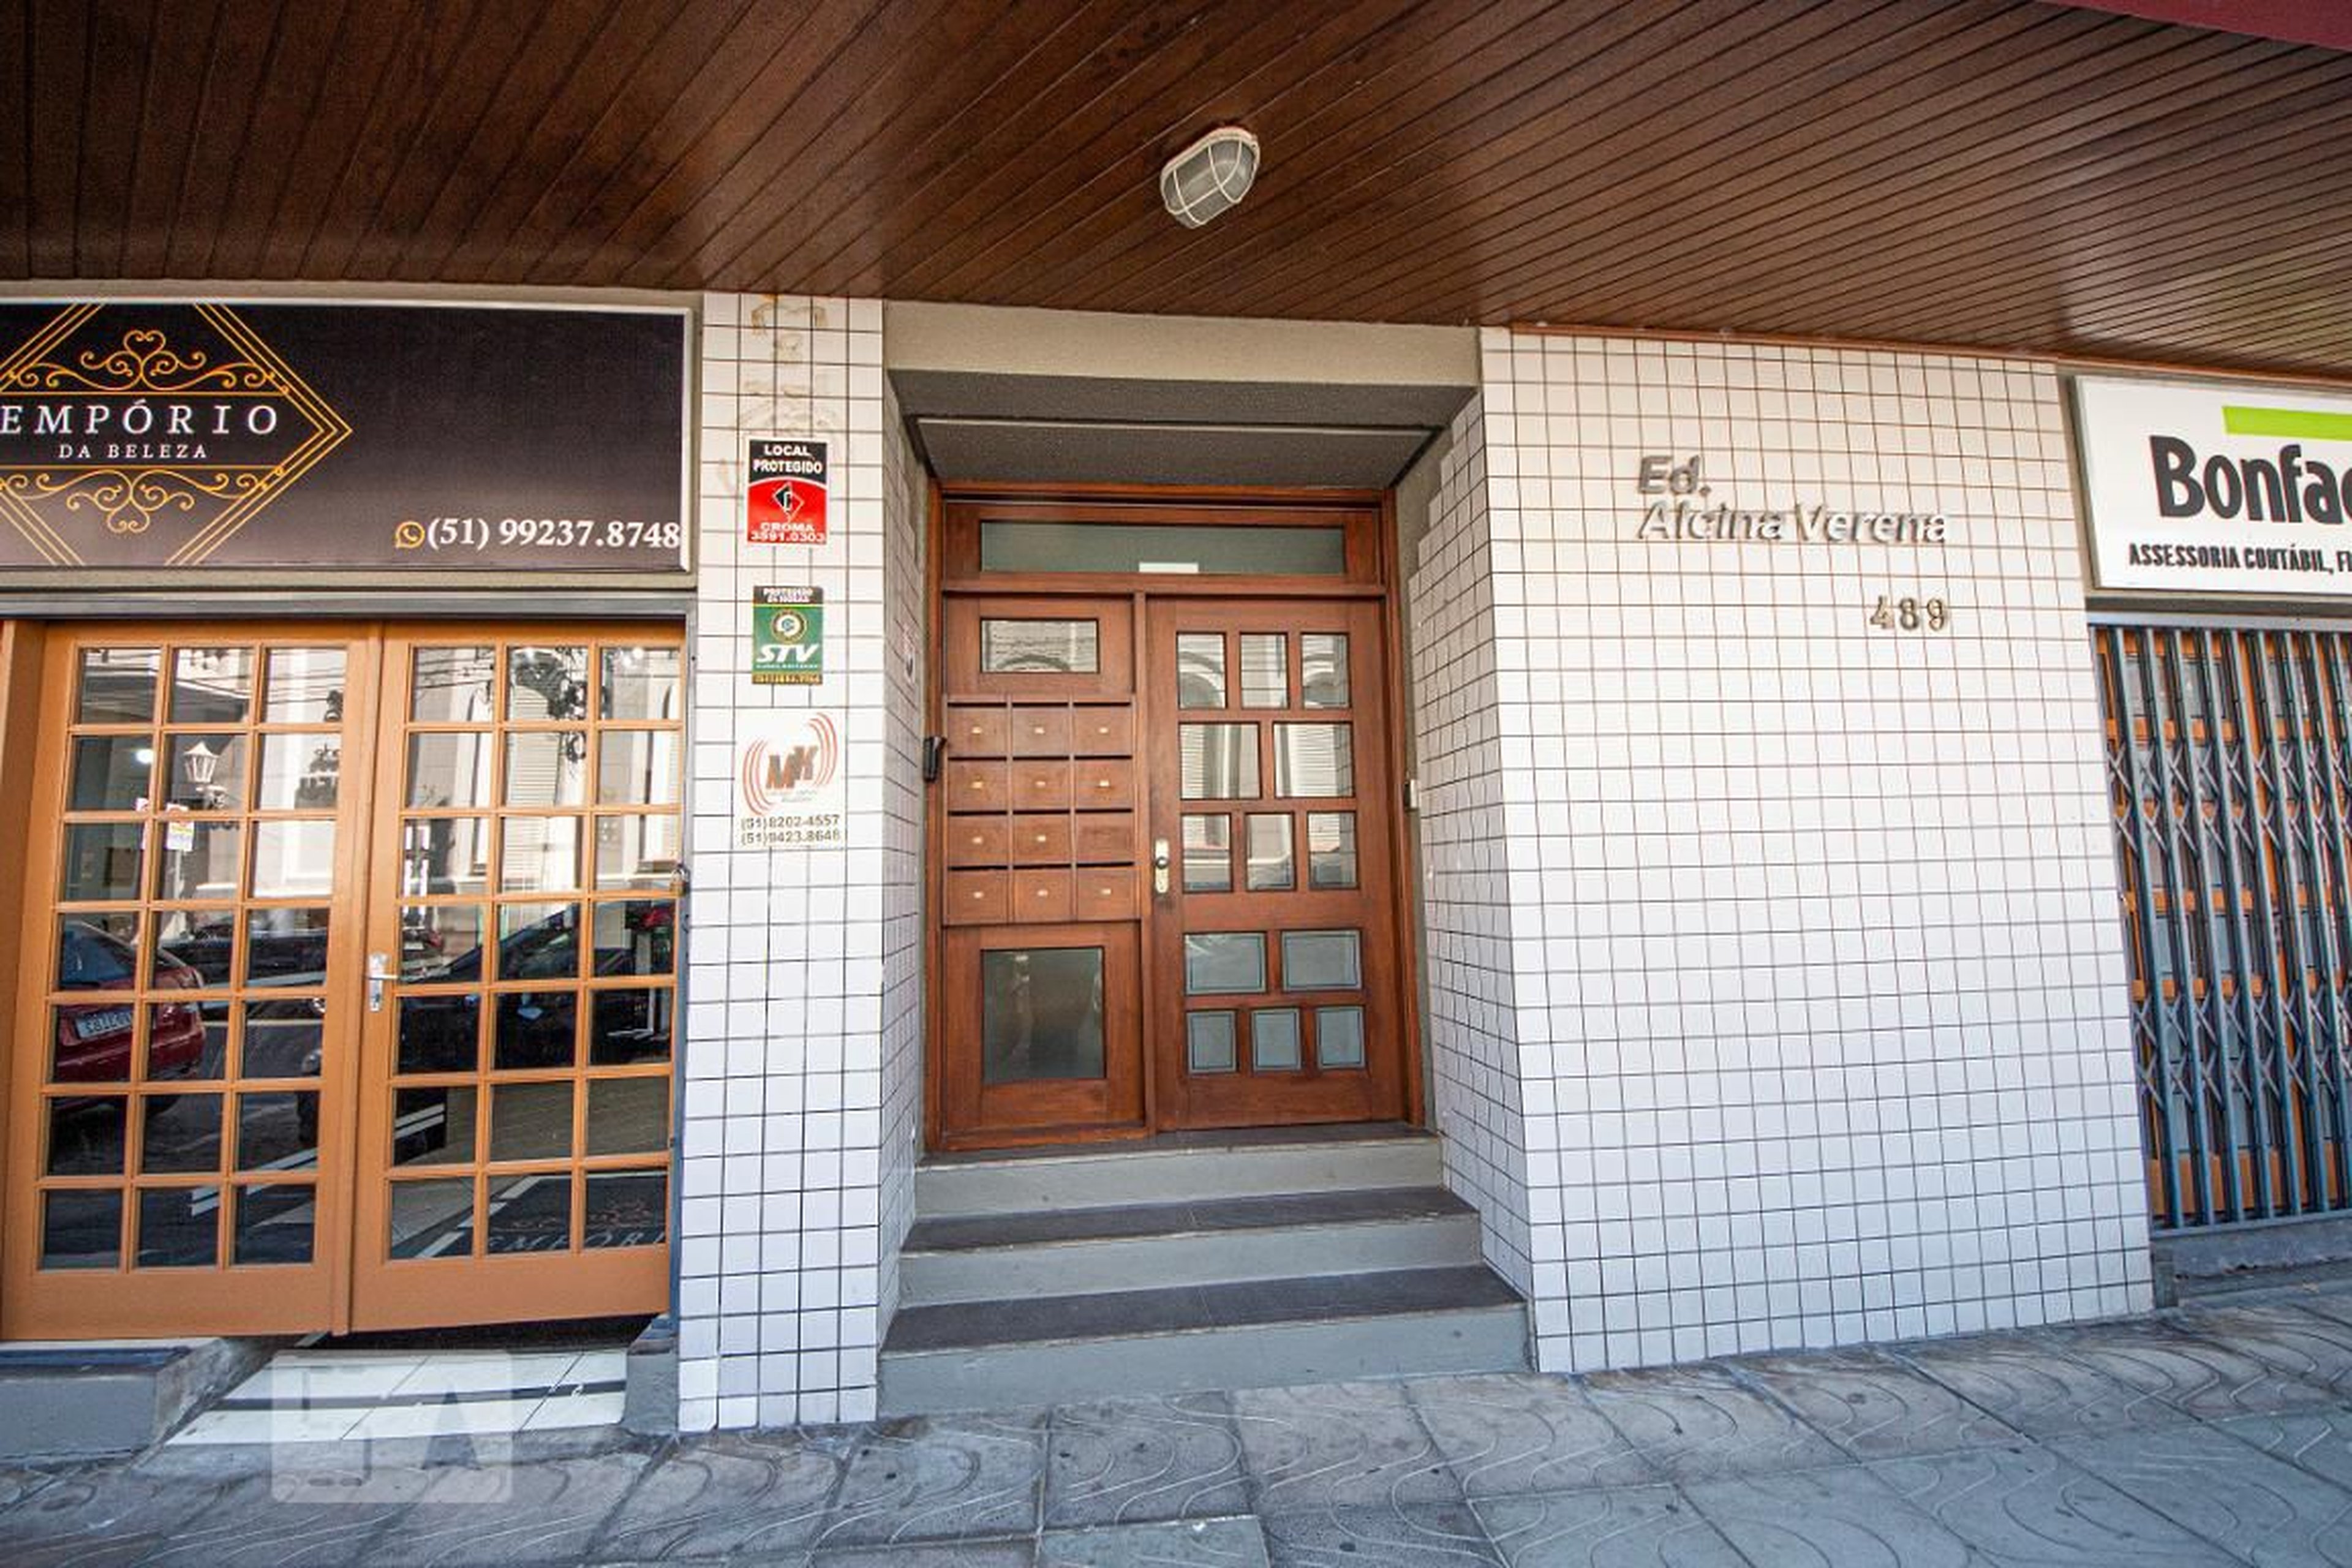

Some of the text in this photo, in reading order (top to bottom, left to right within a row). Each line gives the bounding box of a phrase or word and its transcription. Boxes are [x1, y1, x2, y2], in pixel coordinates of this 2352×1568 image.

[0, 399, 277, 434] EMPÓRIO
[59, 444, 207, 459] DA BELEZA
[753, 459, 823, 473] PROTEGIDO
[764, 445, 812, 456] LOCAL
[1637, 454, 1712, 497] Ed.
[428, 518, 680, 549] (51) 99237.8748
[1638, 502, 1949, 543] Alcina Verena
[2129, 543, 2241, 568] ASSESSORIA
[2244, 545, 2334, 575] CONTÁBIL,
[1870, 596, 1947, 631] 489
[756, 644, 820, 662] STV
